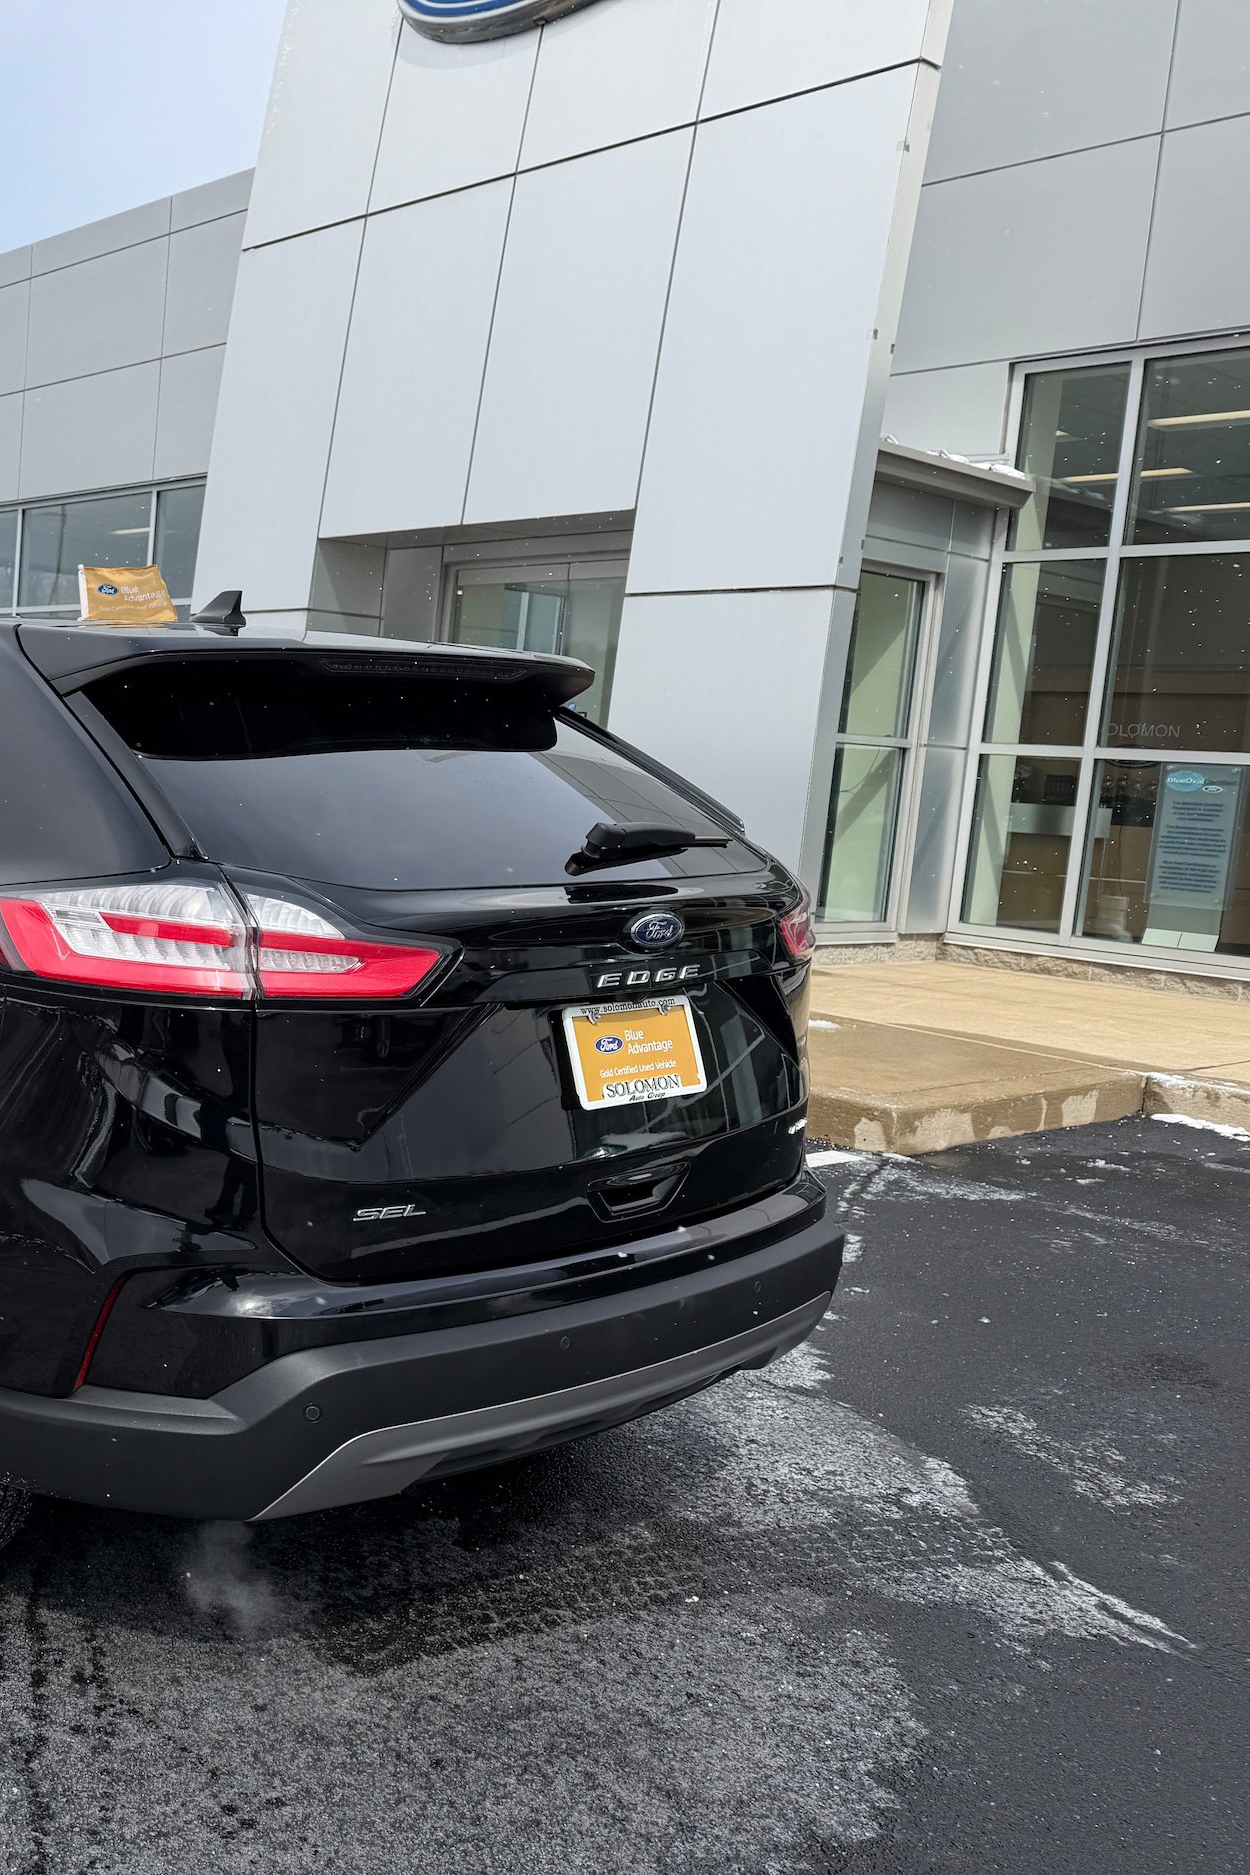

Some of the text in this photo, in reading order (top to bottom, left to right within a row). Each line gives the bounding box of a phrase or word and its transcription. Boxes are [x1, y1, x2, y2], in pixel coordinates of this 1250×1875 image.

[121, 586, 139, 594] Blue
[1107, 723, 1181, 738] OLOMON
[645, 920, 674, 940] Ford
[597, 964, 701, 988] EDGE
[581, 998, 675, 1015] www.solomonauto.com
[624, 1029, 644, 1041] Blue
[599, 1037, 619, 1052] Ford
[627, 1039, 674, 1055] Advantage
[599, 1059, 677, 1078] Gold Certified Used Vehicle
[605, 1074, 680, 1098] SOLOMON
[629, 1092, 666, 1102] Auto Group
[353, 1204, 426, 1221] SEL
